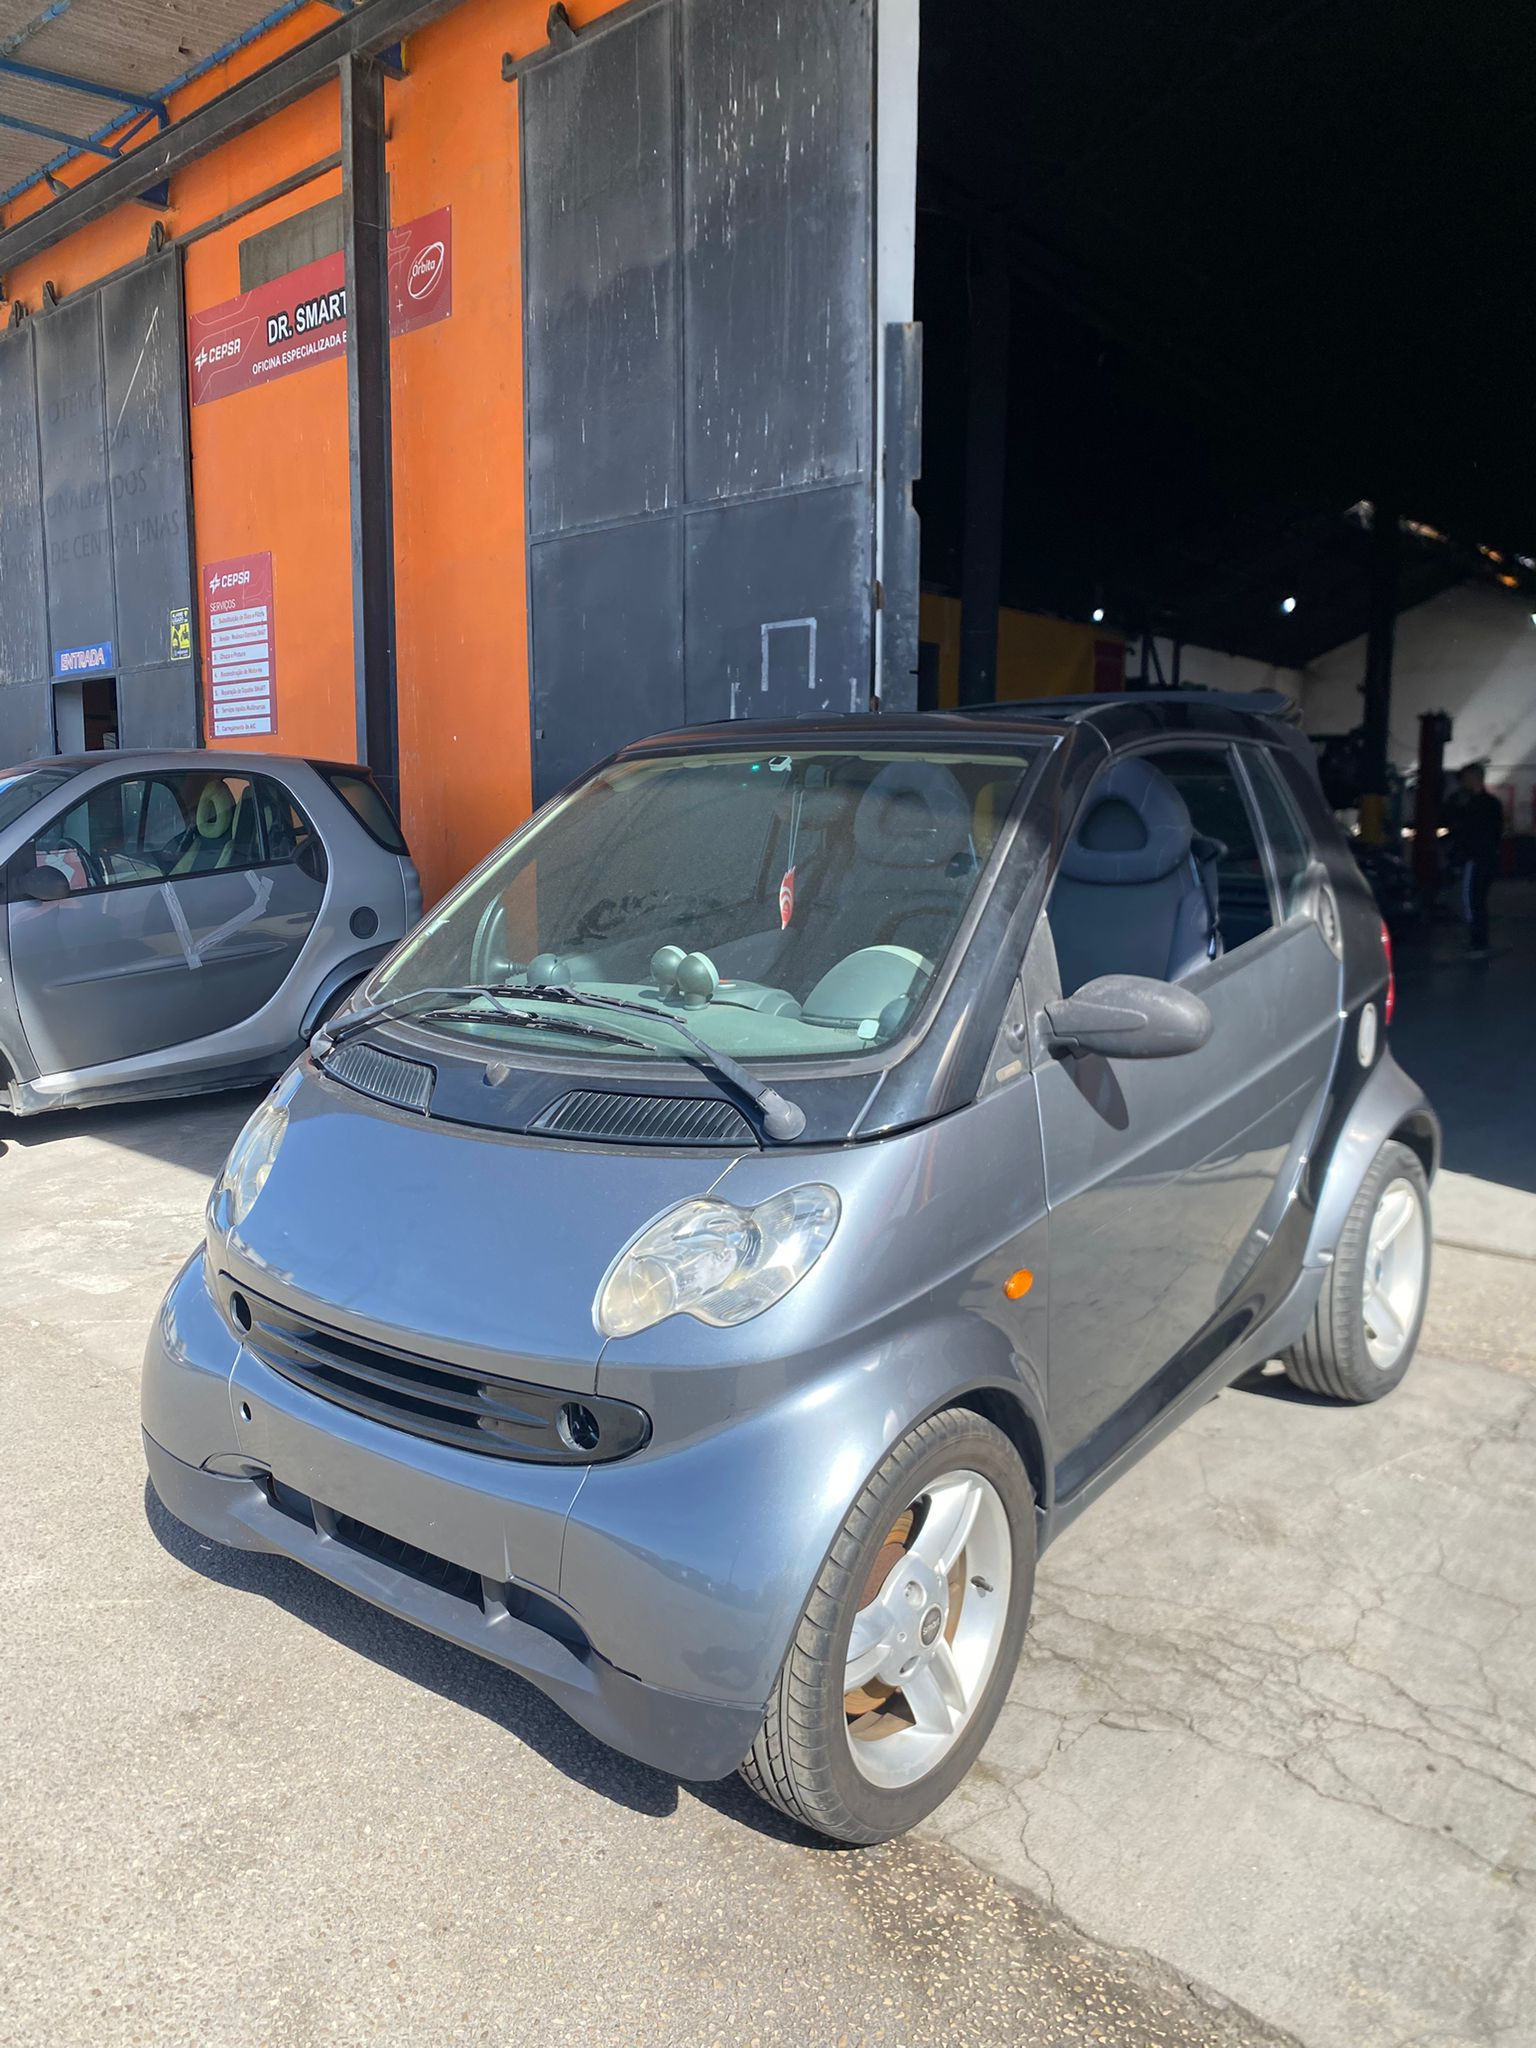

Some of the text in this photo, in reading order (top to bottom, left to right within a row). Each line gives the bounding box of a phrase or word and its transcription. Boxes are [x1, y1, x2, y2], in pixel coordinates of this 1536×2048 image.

[267, 290, 347, 344] DR. SMART
[208, 338, 241, 363] CEPSA
[252, 359, 281, 375] OFICINA
[282, 335, 341, 364] ESPECIALIZADA
[222, 571, 250, 588] CEPSA
[60, 647, 105, 671] ENTRADA
